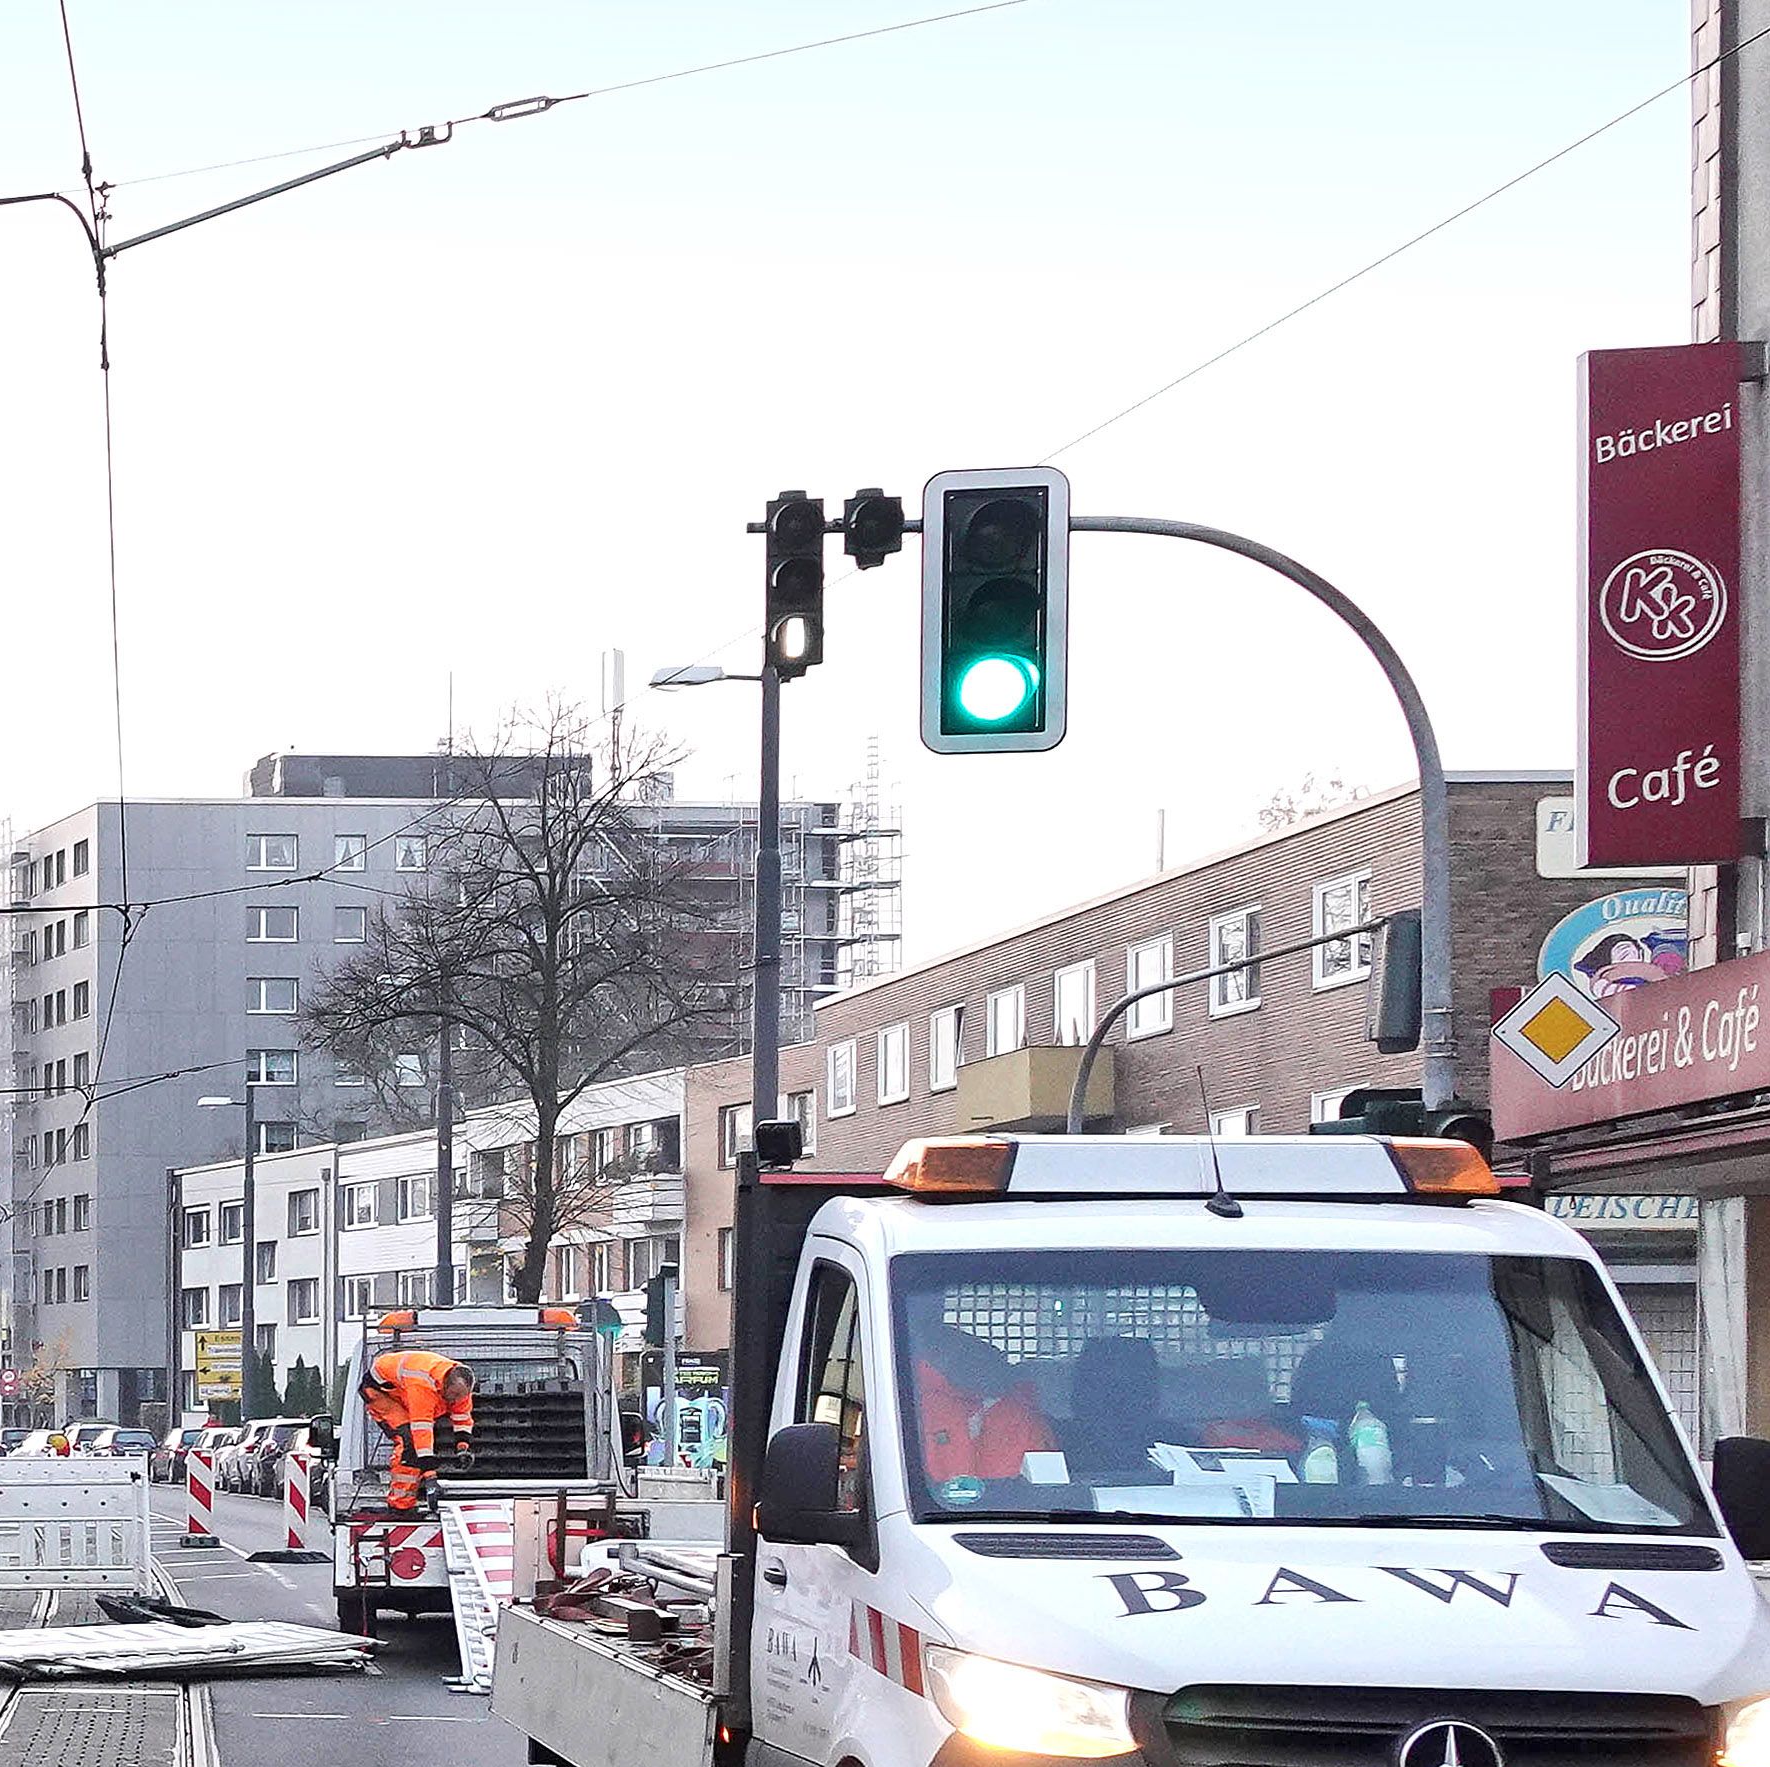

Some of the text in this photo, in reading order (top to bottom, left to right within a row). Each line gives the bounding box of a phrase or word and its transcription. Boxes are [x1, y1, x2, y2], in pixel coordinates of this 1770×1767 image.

[1595, 402, 1732, 463] Bäckerei
[1608, 744, 1720, 809] Café
[1602, 891, 1686, 920] Qualit
[1673, 1006, 1694, 1068] &
[1702, 984, 1760, 1071] Café
[1092, 1567, 1699, 1631] BAWA
